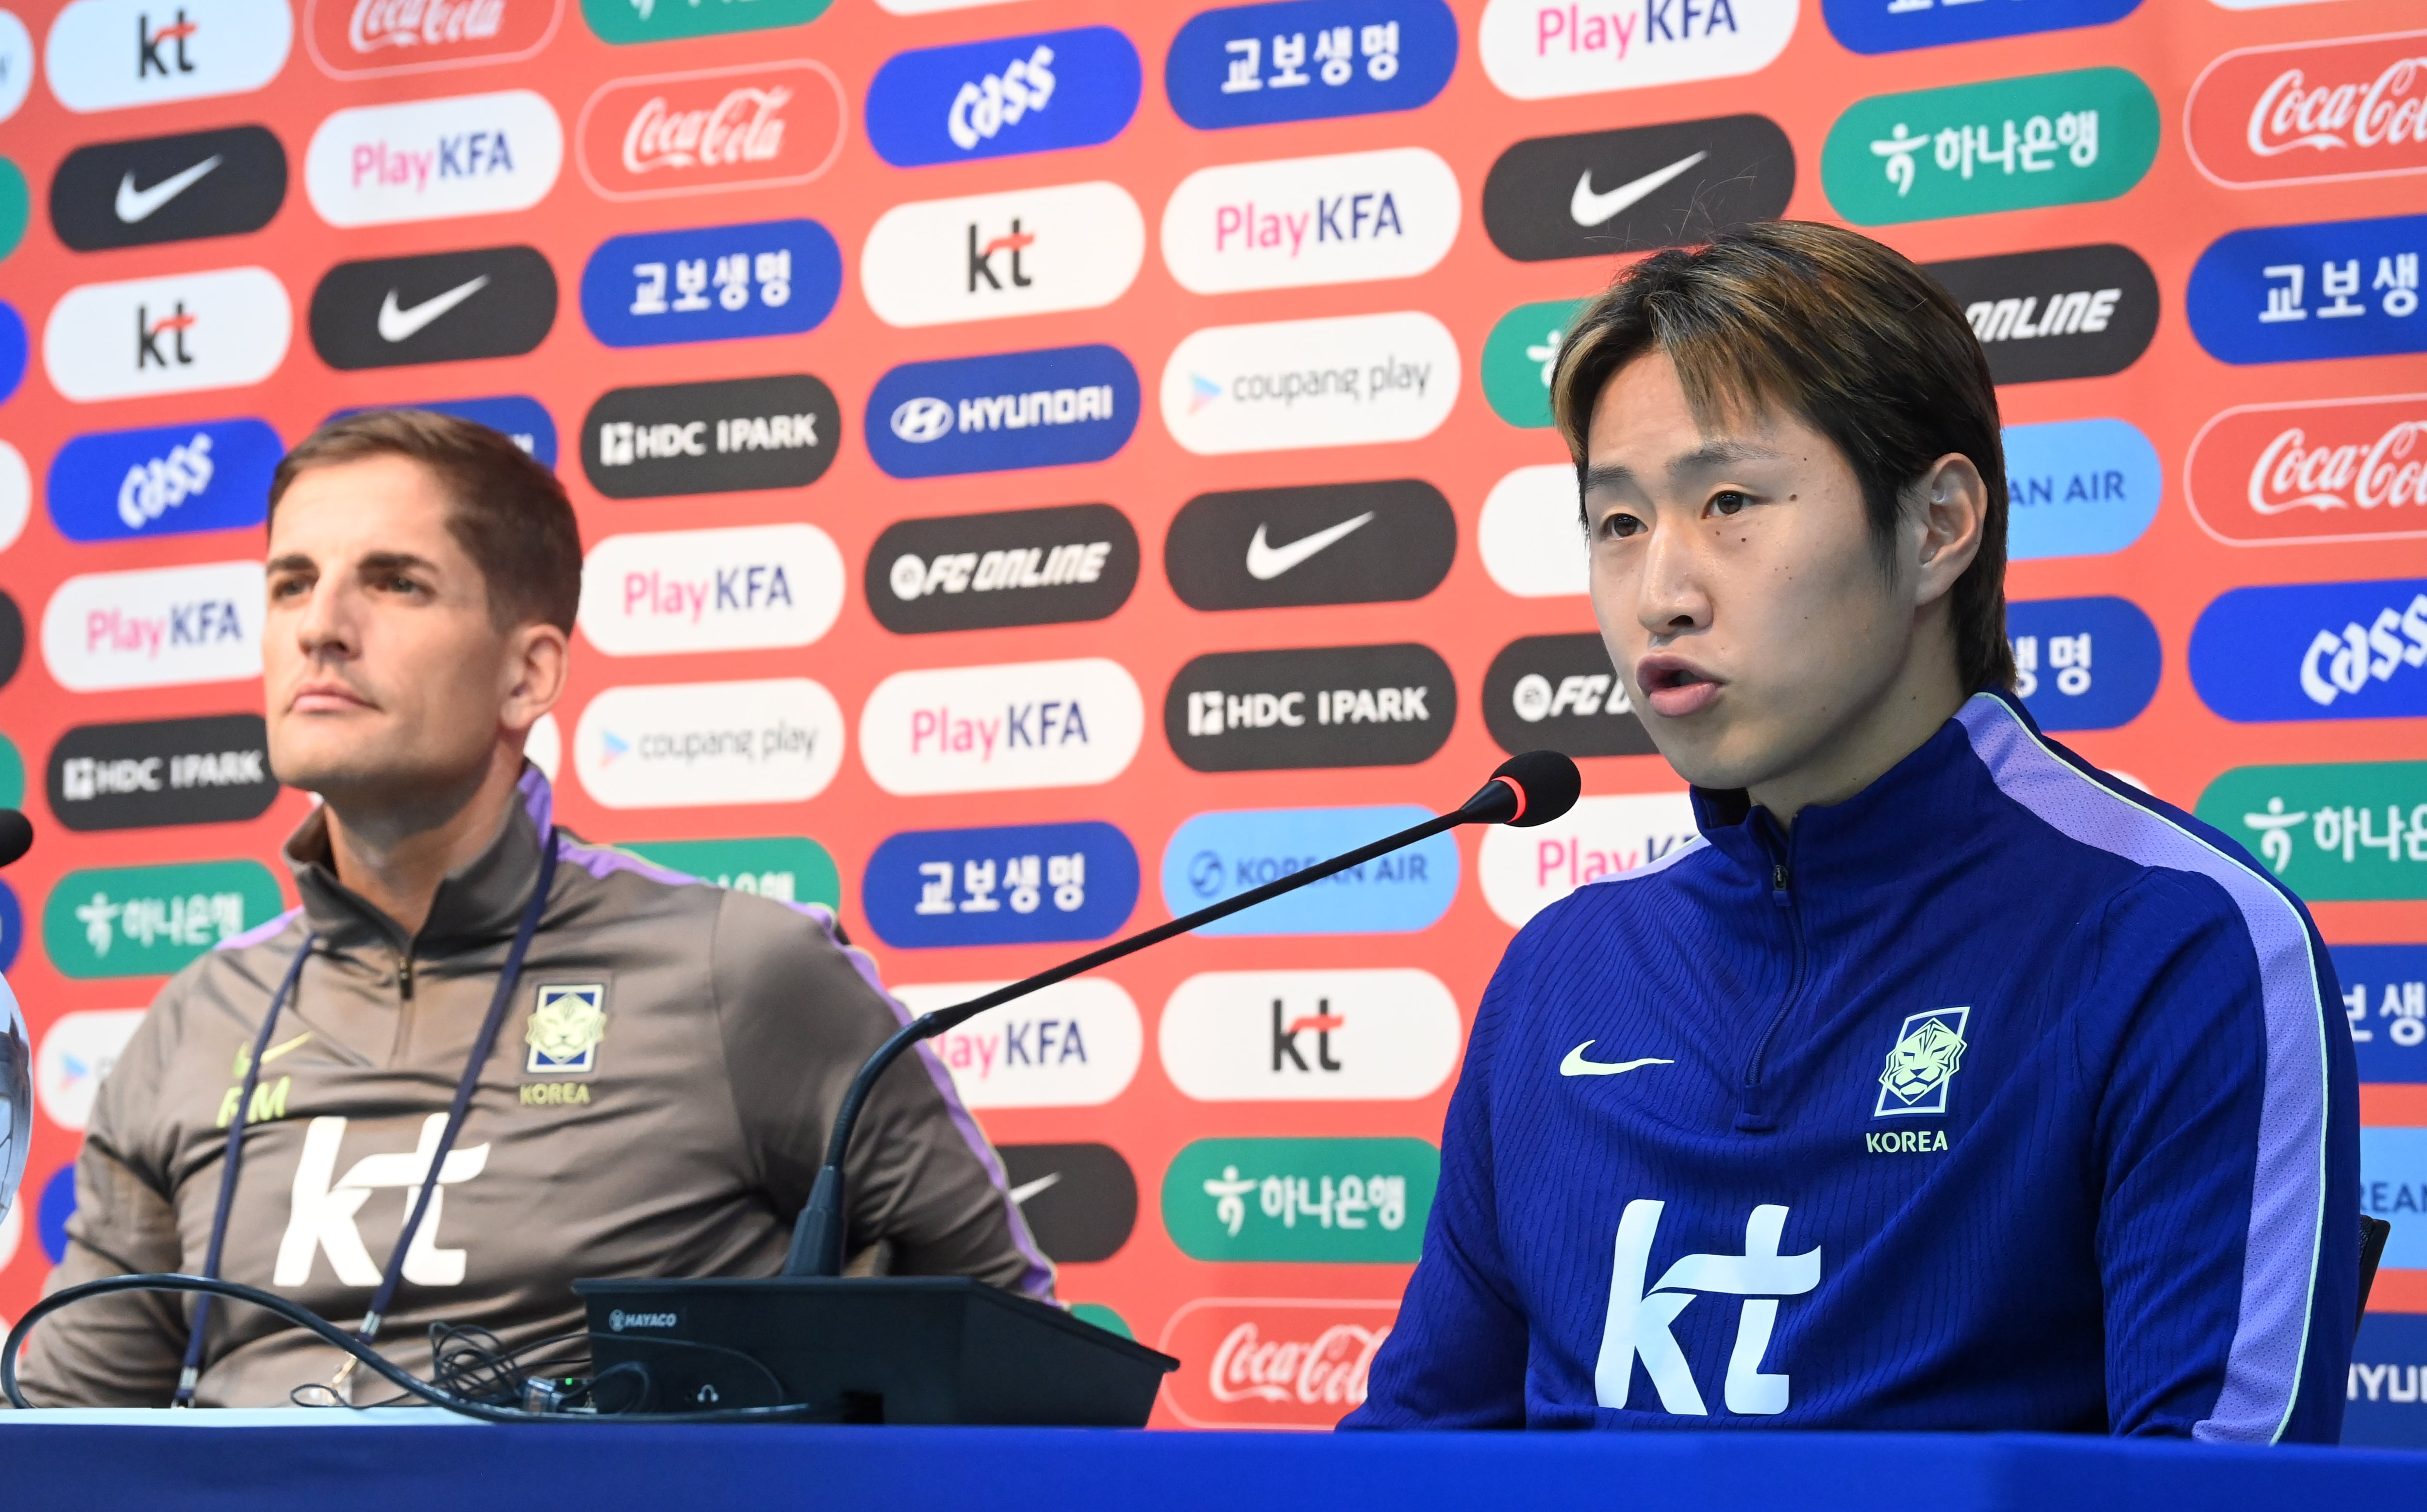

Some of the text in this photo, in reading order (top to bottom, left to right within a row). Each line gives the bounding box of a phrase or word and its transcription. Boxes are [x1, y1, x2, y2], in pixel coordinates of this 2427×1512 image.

[138, 9, 198, 79] kt
[1221, 20, 1400, 94] 교보생명
[2247, 56, 2427, 157] Coca-Co
[1935, 110, 2098, 179] 하나은행
[630, 249, 791, 316] 교보생명
[967, 217, 1035, 293] kt
[1965, 287, 2123, 342] ONLINE
[2257, 252, 2419, 324] 교보생
[137, 301, 197, 370] kt
[958, 384, 1114, 433] HYUNDAI
[1232, 355, 1431, 407] coupang play
[635, 413, 818, 458] HDC IPARK
[2064, 469, 2126, 503] AIR
[2247, 420, 2427, 515] Coca-Co
[922, 541, 1112, 596] FC ONLINE
[1548, 674, 1612, 717] FC
[2009, 632, 2093, 698] 생명
[1226, 686, 1430, 729] HDC IPARK
[639, 720, 818, 764] coupang play
[2312, 803, 2427, 863] 하나은
[915, 852, 1085, 915] 교보생명
[1375, 852, 1429, 884] AIR
[1271, 997, 1345, 1073] kt
[519, 1082, 591, 1105] KOREA
[1865, 1130, 1949, 1154] KOREA
[272, 1112, 491, 1287] kt
[1258, 1174, 1406, 1231] 하나은행
[625, 1313, 677, 1328] HAYACO
[1594, 1198, 1822, 1416] kt
[1209, 1322, 1391, 1406] Coca-Col
